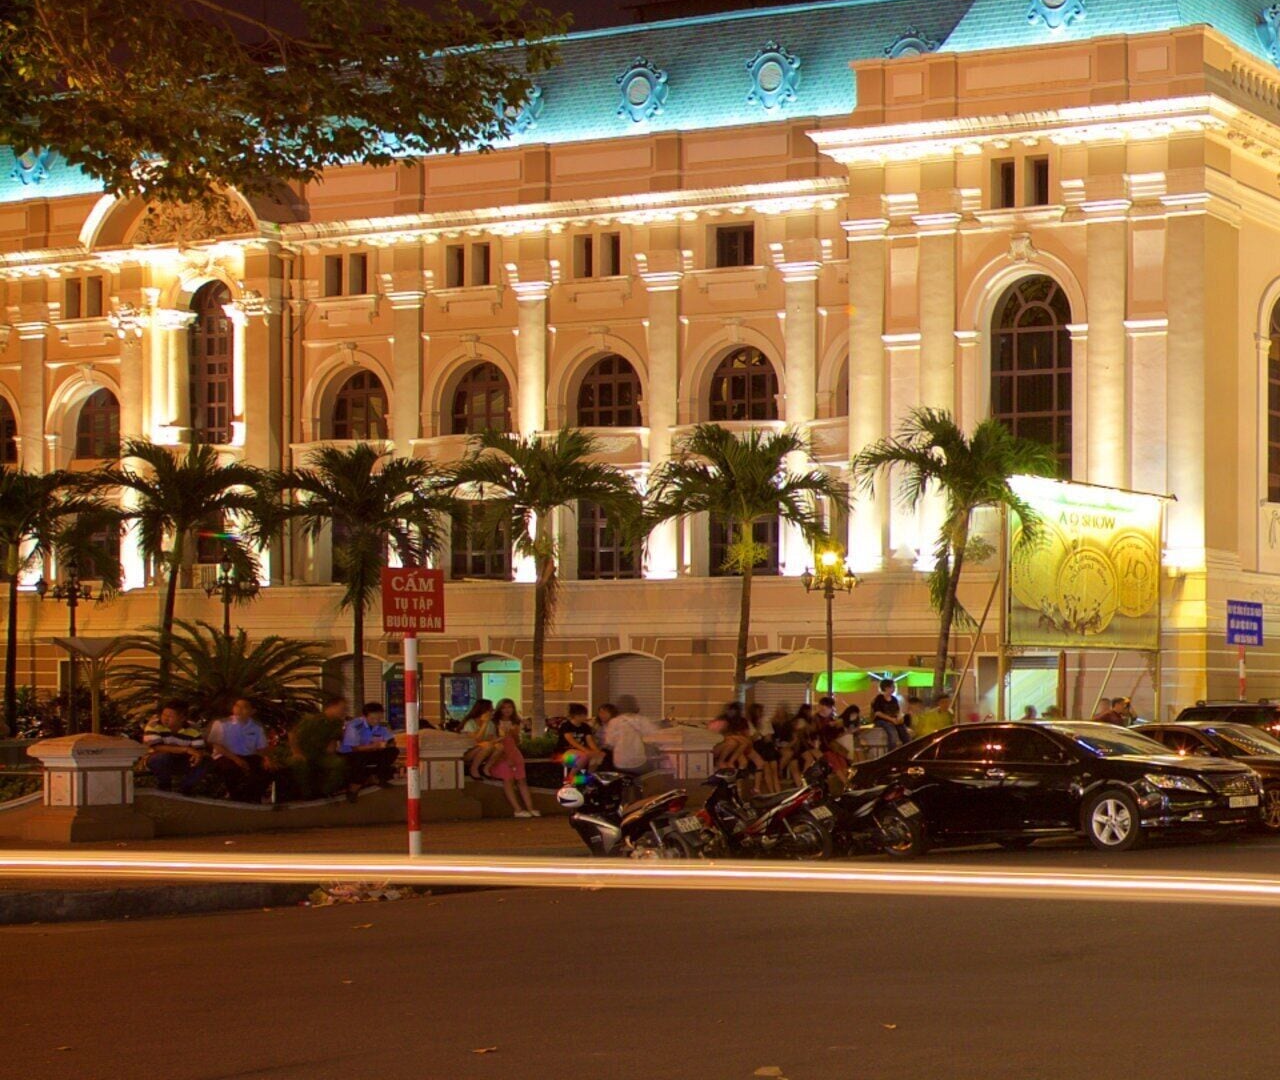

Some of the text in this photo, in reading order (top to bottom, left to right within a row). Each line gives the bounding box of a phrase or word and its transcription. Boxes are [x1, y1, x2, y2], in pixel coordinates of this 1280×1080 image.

[1081, 515, 1116, 530] SHOW
[391, 571, 435, 593] CẤM
[394, 596, 433, 613] TỤ TẬP
[386, 613, 417, 628] BUÔN
